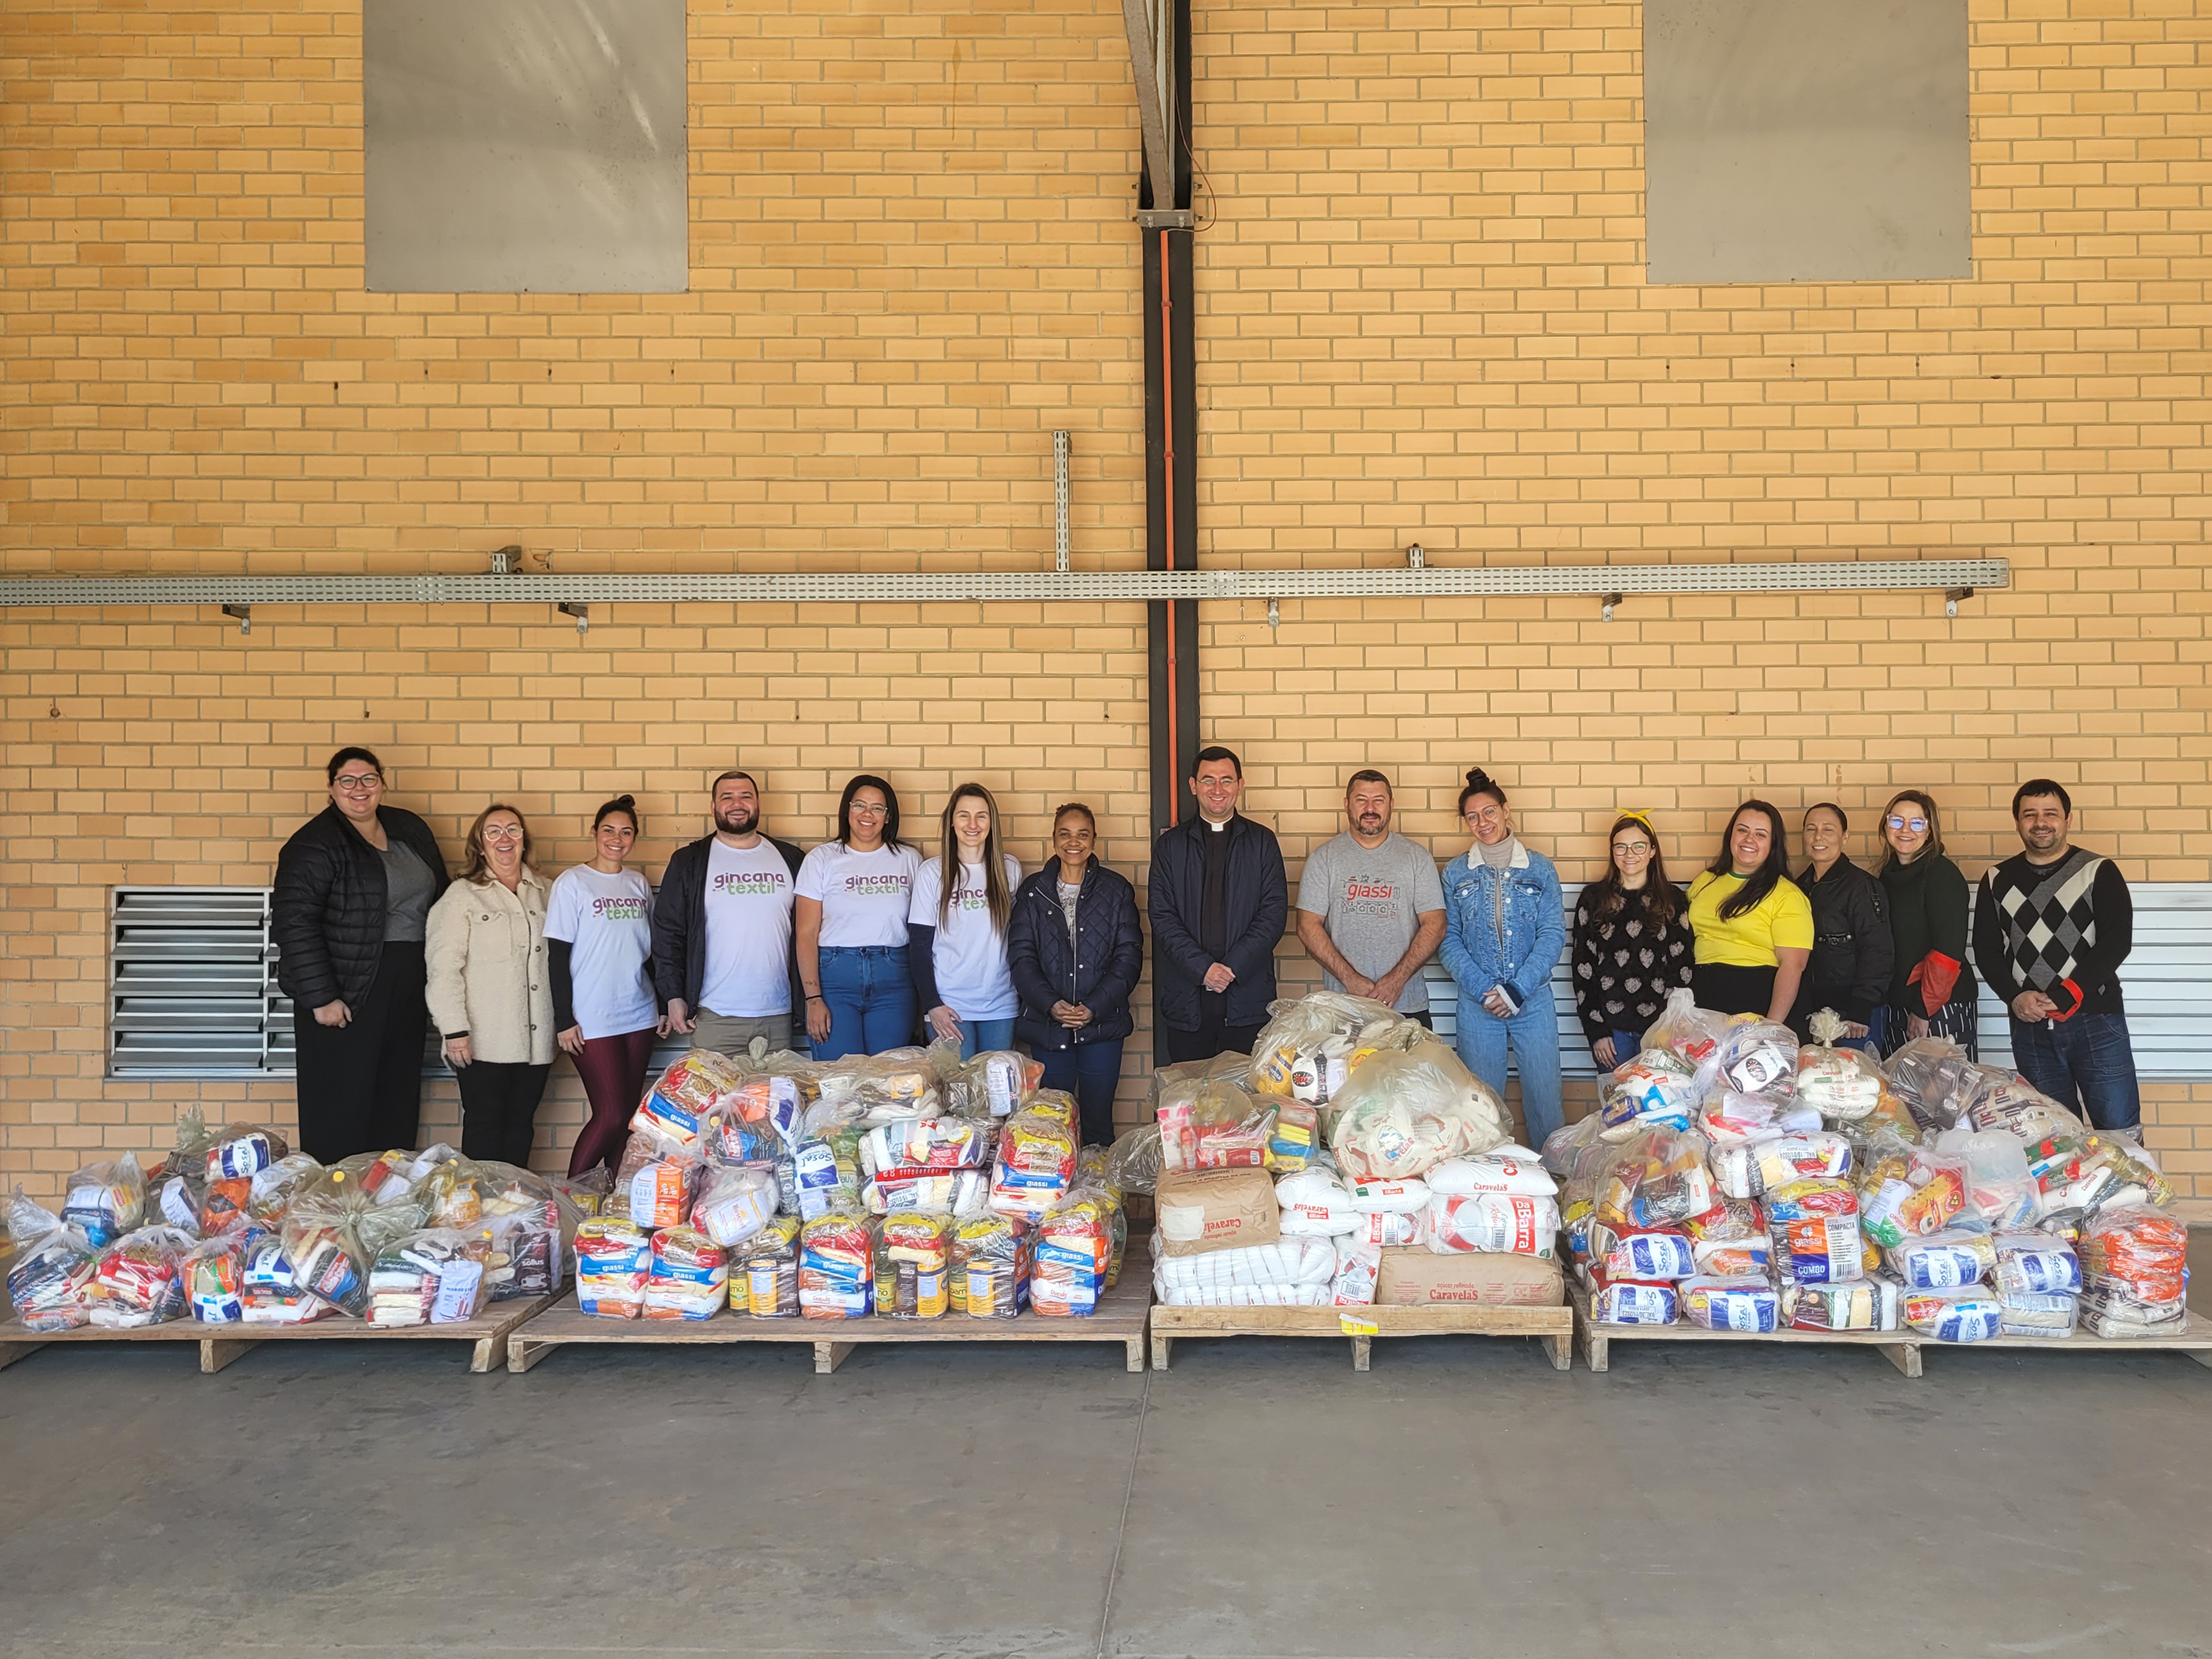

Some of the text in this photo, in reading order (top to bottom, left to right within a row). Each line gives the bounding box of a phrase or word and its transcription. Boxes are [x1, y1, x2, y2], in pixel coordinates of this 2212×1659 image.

[714, 872, 785, 888] gincana
[845, 874, 907, 889] gincana
[592, 896, 647, 914] gincana
[1827, 1222, 1855, 1232] COMPACTA
[1794, 1238, 1822, 1247] giassi
[1061, 1252, 1084, 1261] giassi
[1798, 1265, 1826, 1275] COMBO
[673, 1271, 696, 1280] giassi
[1430, 1289, 1479, 1301] Caravelas
